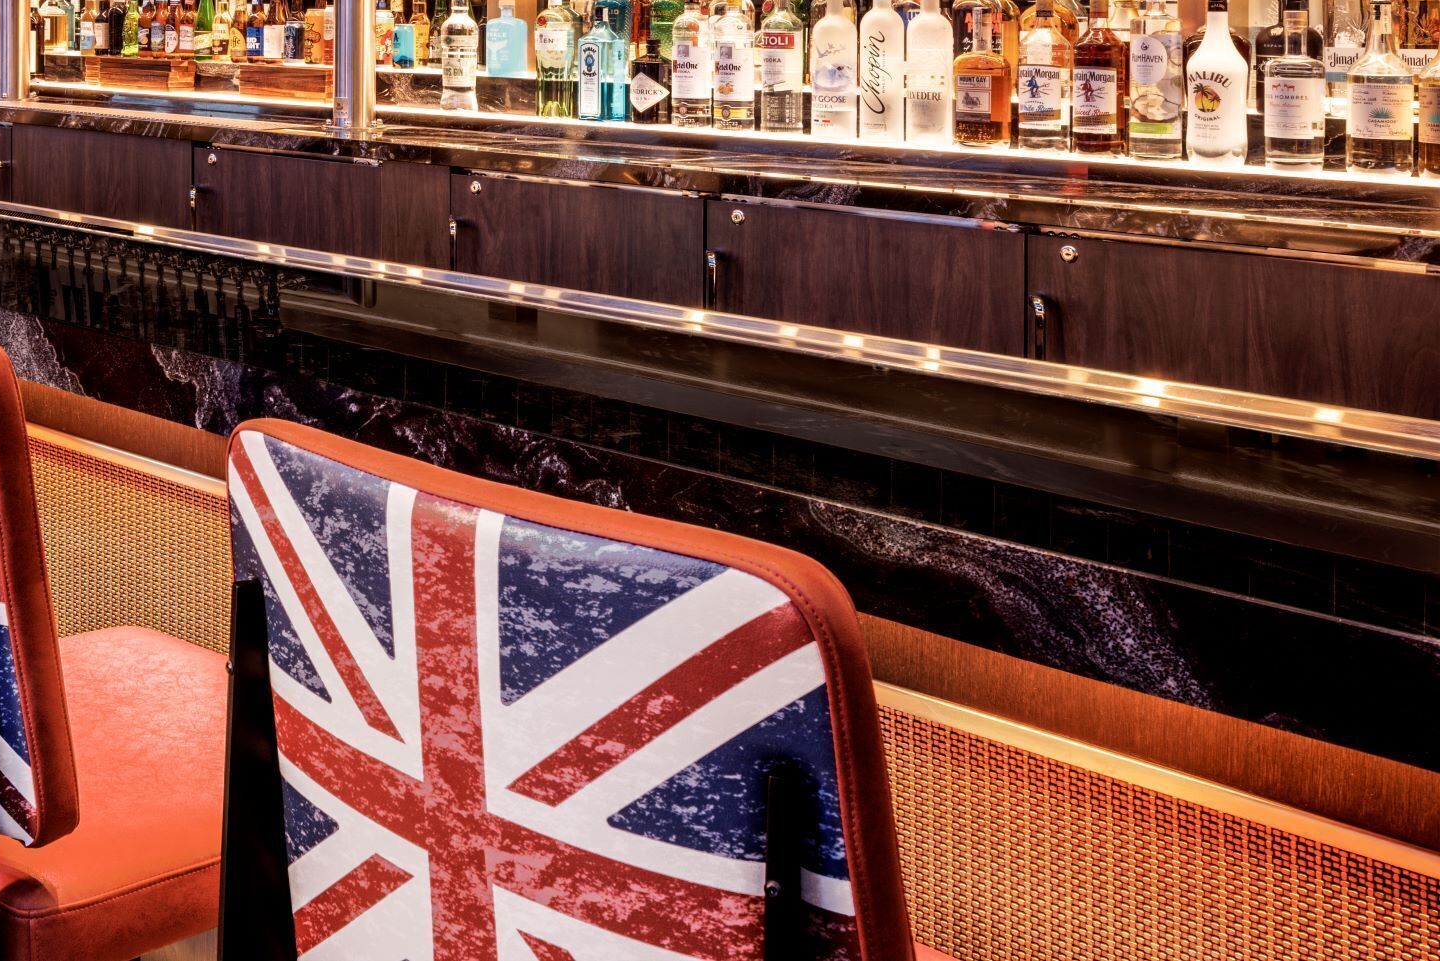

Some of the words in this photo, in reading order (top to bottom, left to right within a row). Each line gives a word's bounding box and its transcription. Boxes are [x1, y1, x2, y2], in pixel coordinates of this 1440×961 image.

[686, 61, 698, 70] One
[1330, 52, 1359, 68] Jimad
[1401, 53, 1433, 68] imado
[729, 63, 742, 72] One
[862, 31, 893, 115] Chopin
[1034, 68, 1060, 80] Morgan
[1088, 71, 1115, 83] Morgan
[1188, 71, 1233, 89] MALIBU
[632, 88, 664, 96] NDRICK'S
[909, 89, 943, 101] LVEDERE
[819, 94, 847, 103] GOOSE
[1194, 113, 1221, 122] ORIGINAL
